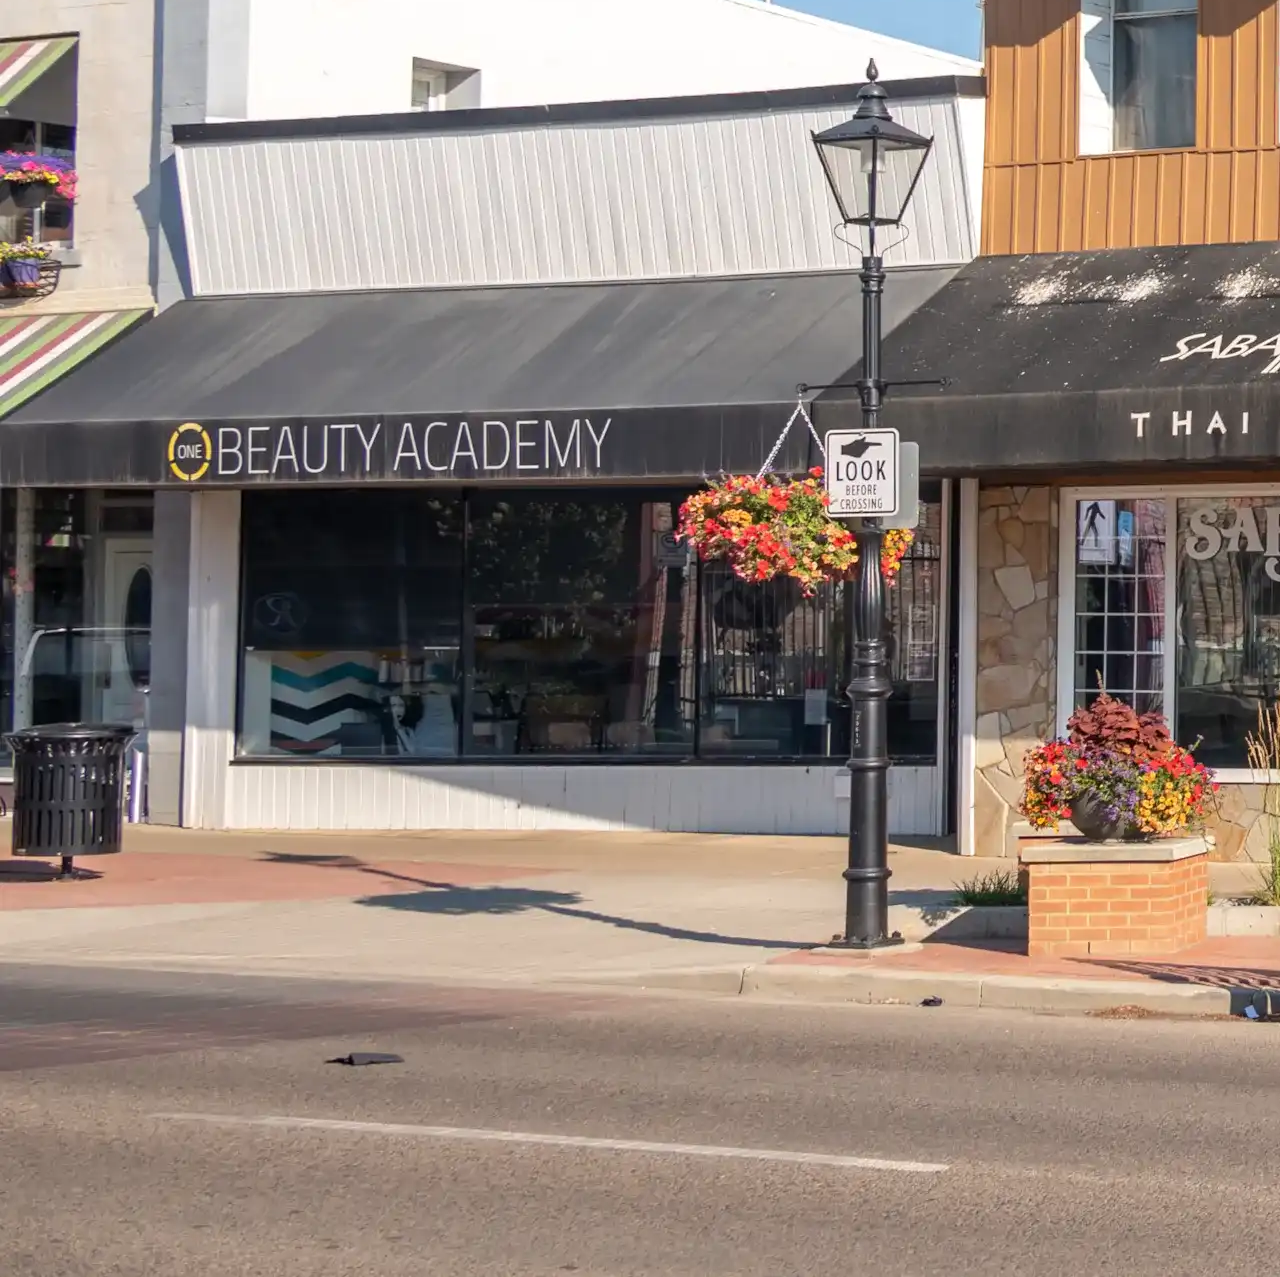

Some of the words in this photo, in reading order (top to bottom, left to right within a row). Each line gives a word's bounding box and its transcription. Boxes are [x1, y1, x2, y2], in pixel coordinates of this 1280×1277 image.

[1130, 410, 1250, 438] THAI
[177, 443, 203, 460] ONE
[217, 423, 382, 475] BEAUTY
[393, 418, 612, 472] ACADEMY
[836, 459, 886, 482] LOOK
[845, 483, 878, 496] BEFORE
[839, 497, 883, 510] CROSSING
